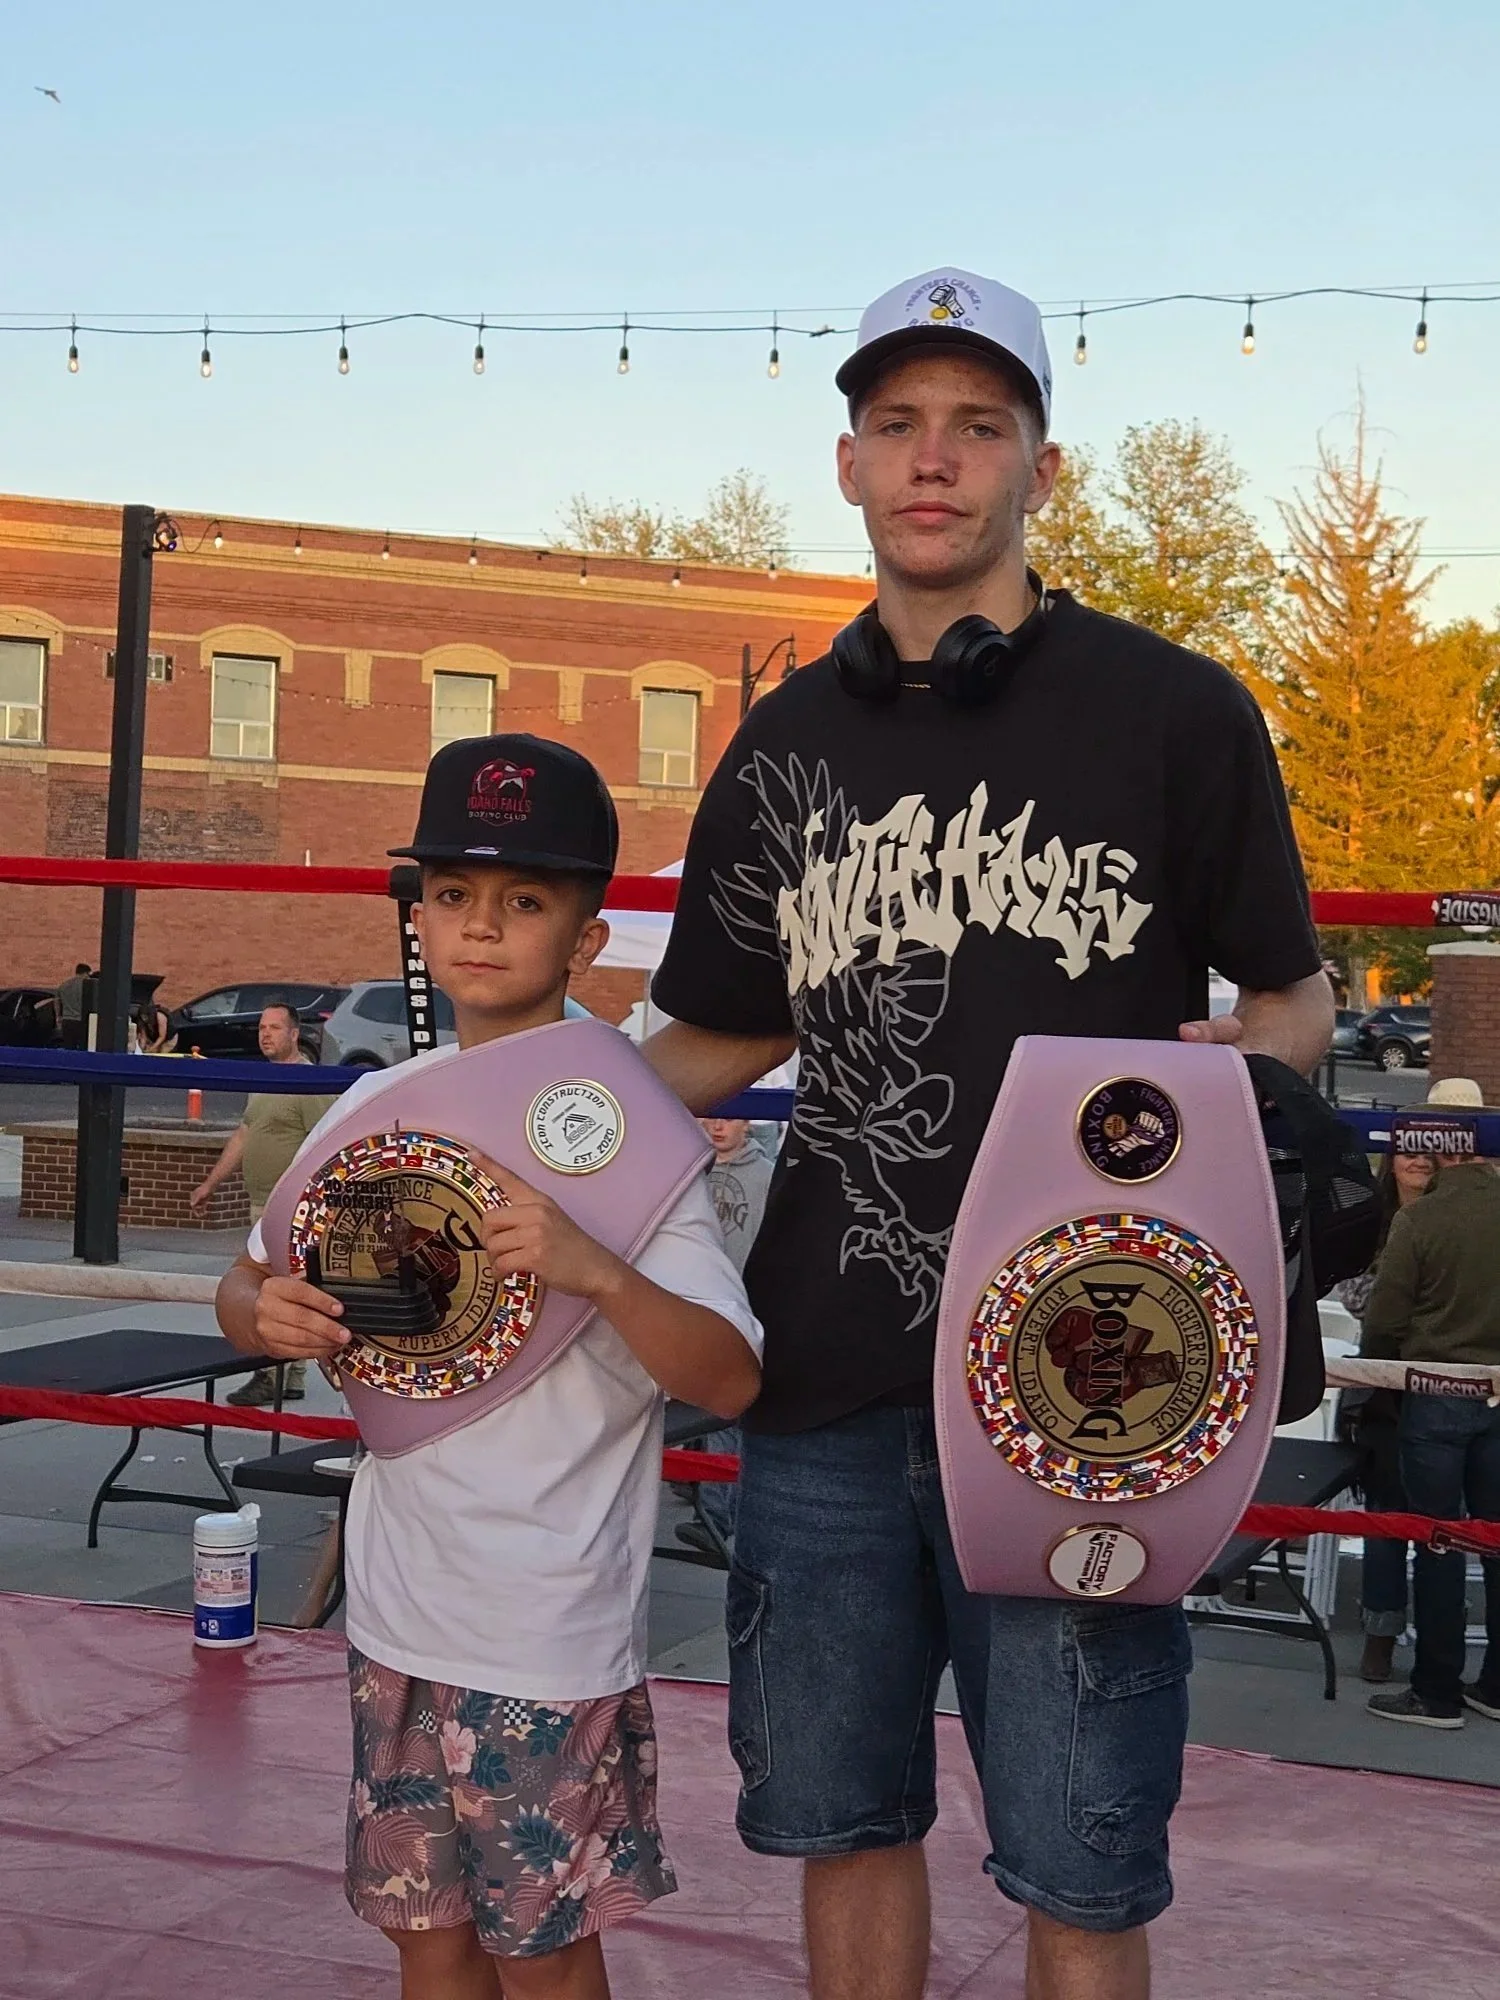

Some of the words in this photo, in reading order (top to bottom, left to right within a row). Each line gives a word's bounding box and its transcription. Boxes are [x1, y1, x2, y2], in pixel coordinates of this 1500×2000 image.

[467, 796, 498, 809] IDAHO
[501, 797, 532, 813] FALLS
[468, 811, 500, 819] BOXING
[504, 812, 527, 820] CLUB
[1441, 898, 1500, 926] NGSIDE
[1088, 1090, 1113, 1167] BOXING
[1139, 1137, 1173, 1172] CHANCE
[1395, 1129, 1474, 1154] RINGSIDE
[1159, 1286, 1206, 1366] FIGHTER'S
[1067, 1279, 1145, 1440] BOXING
[1020, 1370, 1059, 1430] IDAHO
[1150, 1371, 1205, 1435] CHANCE
[1093, 1533, 1118, 1591] FACTORY
